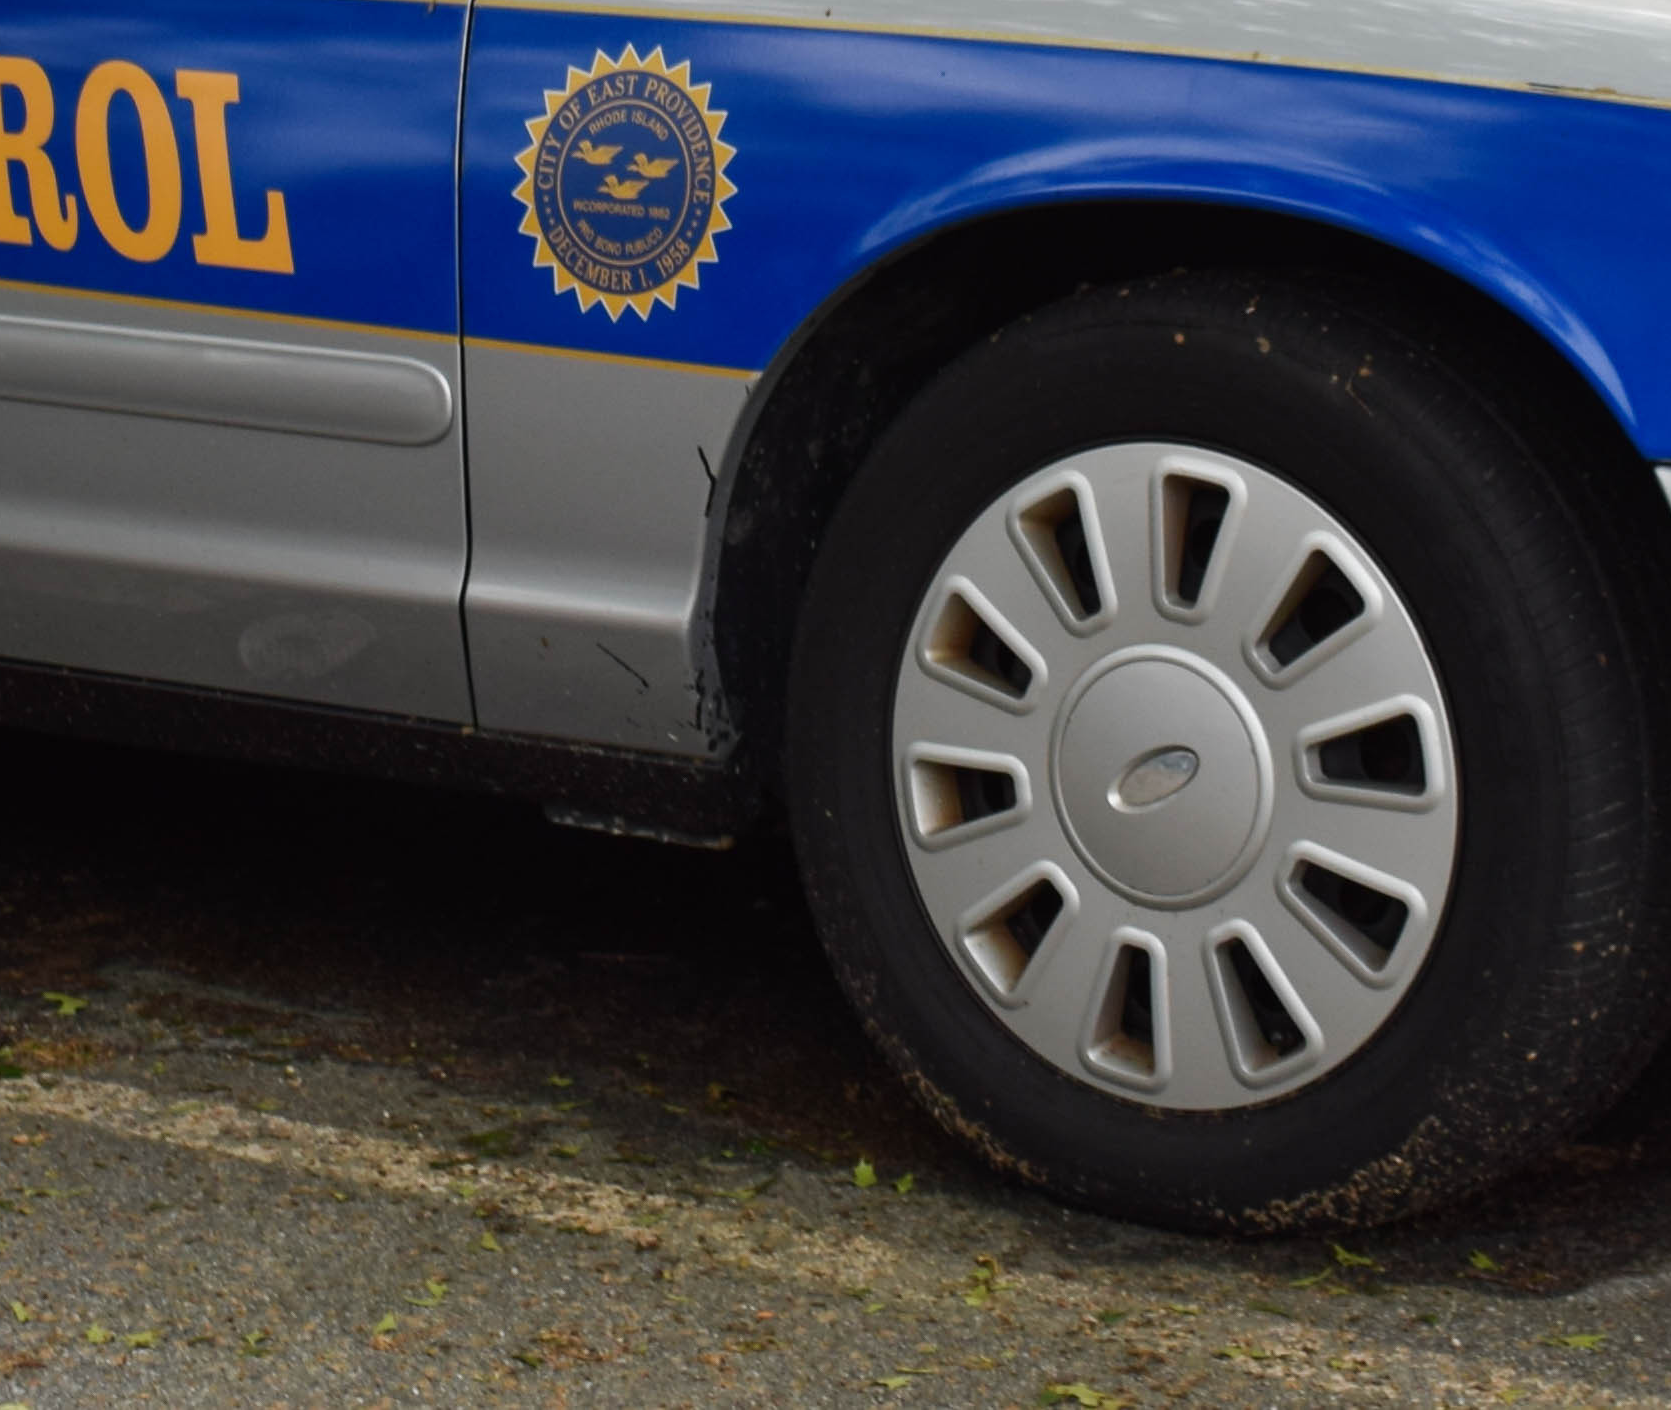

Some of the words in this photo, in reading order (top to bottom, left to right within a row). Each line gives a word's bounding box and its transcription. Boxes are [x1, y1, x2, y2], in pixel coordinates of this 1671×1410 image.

[536, 131, 562, 190] CITY
[559, 97, 581, 130] OF
[586, 74, 639, 106] EAST
[644, 76, 712, 204] PROVIDENCE
[588, 108, 628, 136] RHODE
[630, 109, 670, 141] ISLAND
[548, 225, 633, 291] DECEMBER
[655, 237, 692, 280] 1958
